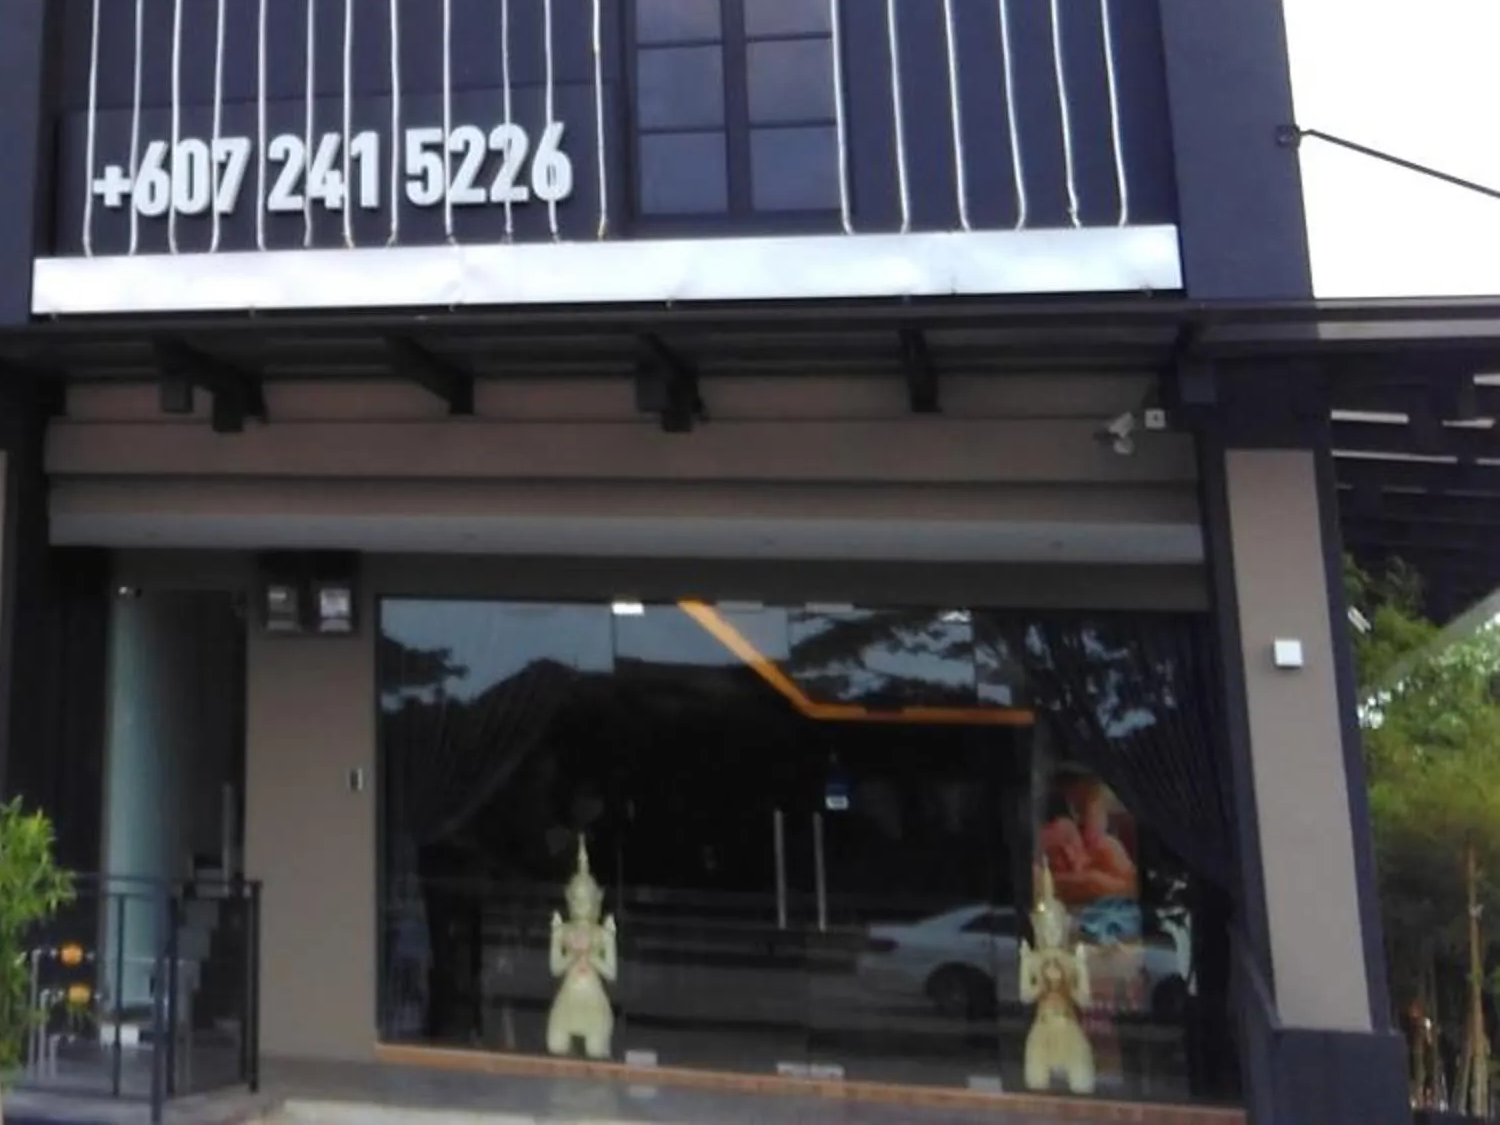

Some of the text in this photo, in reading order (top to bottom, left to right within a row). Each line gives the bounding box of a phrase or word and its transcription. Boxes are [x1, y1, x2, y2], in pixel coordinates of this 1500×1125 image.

[93, 122, 574, 217] +607 241 5226
